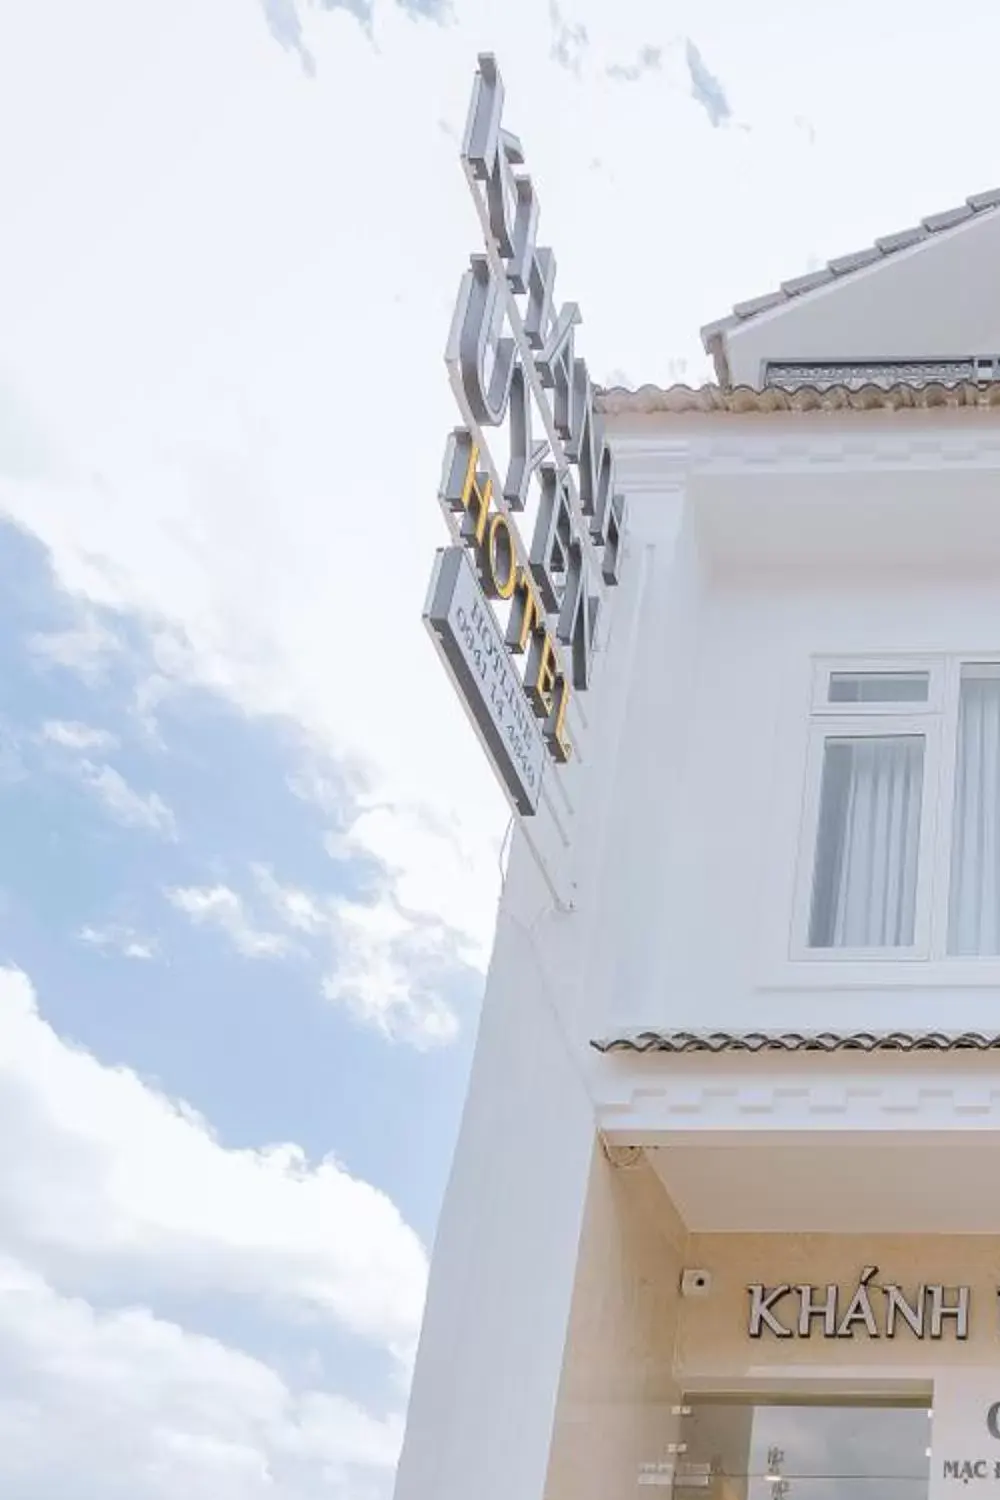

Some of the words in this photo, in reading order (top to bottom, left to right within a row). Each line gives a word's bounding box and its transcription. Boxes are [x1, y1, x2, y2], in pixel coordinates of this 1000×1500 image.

[439, 424, 572, 764] HOTEL
[747, 1266, 971, 1341] KHÁNH
[943, 1460, 986, 1484] MẠC
